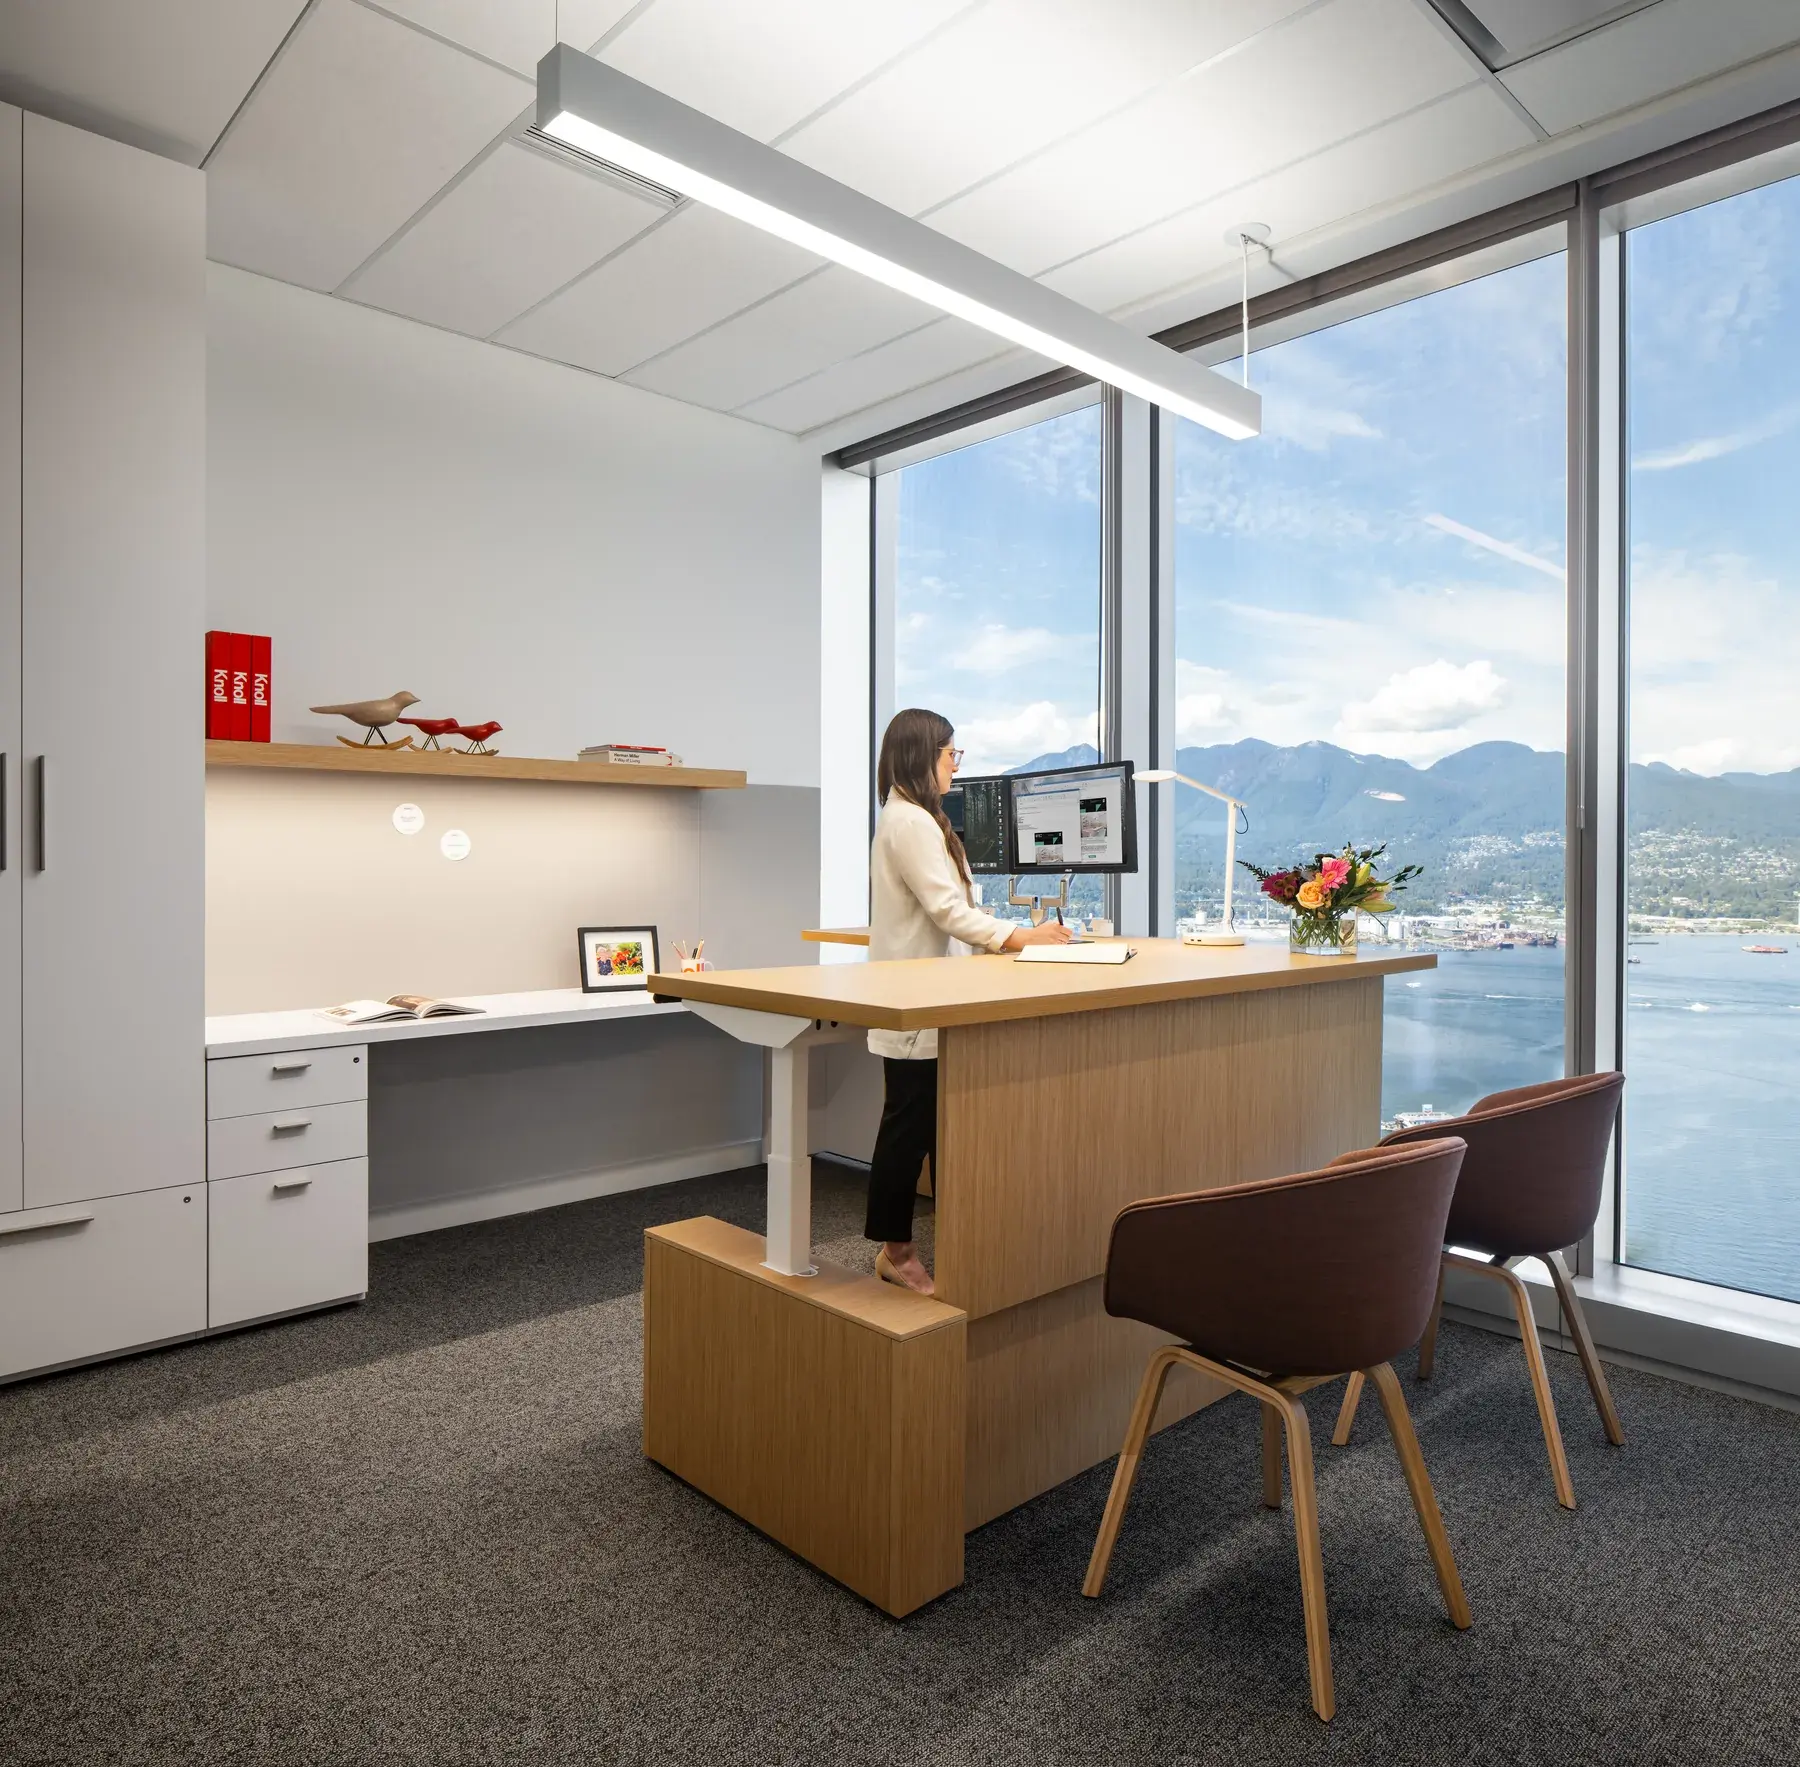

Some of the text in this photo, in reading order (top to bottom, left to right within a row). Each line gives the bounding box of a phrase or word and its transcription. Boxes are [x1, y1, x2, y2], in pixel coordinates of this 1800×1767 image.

[213, 669, 228, 702] Knoll
[233, 671, 247, 704] Knoll
[253, 673, 268, 706] Knoll
